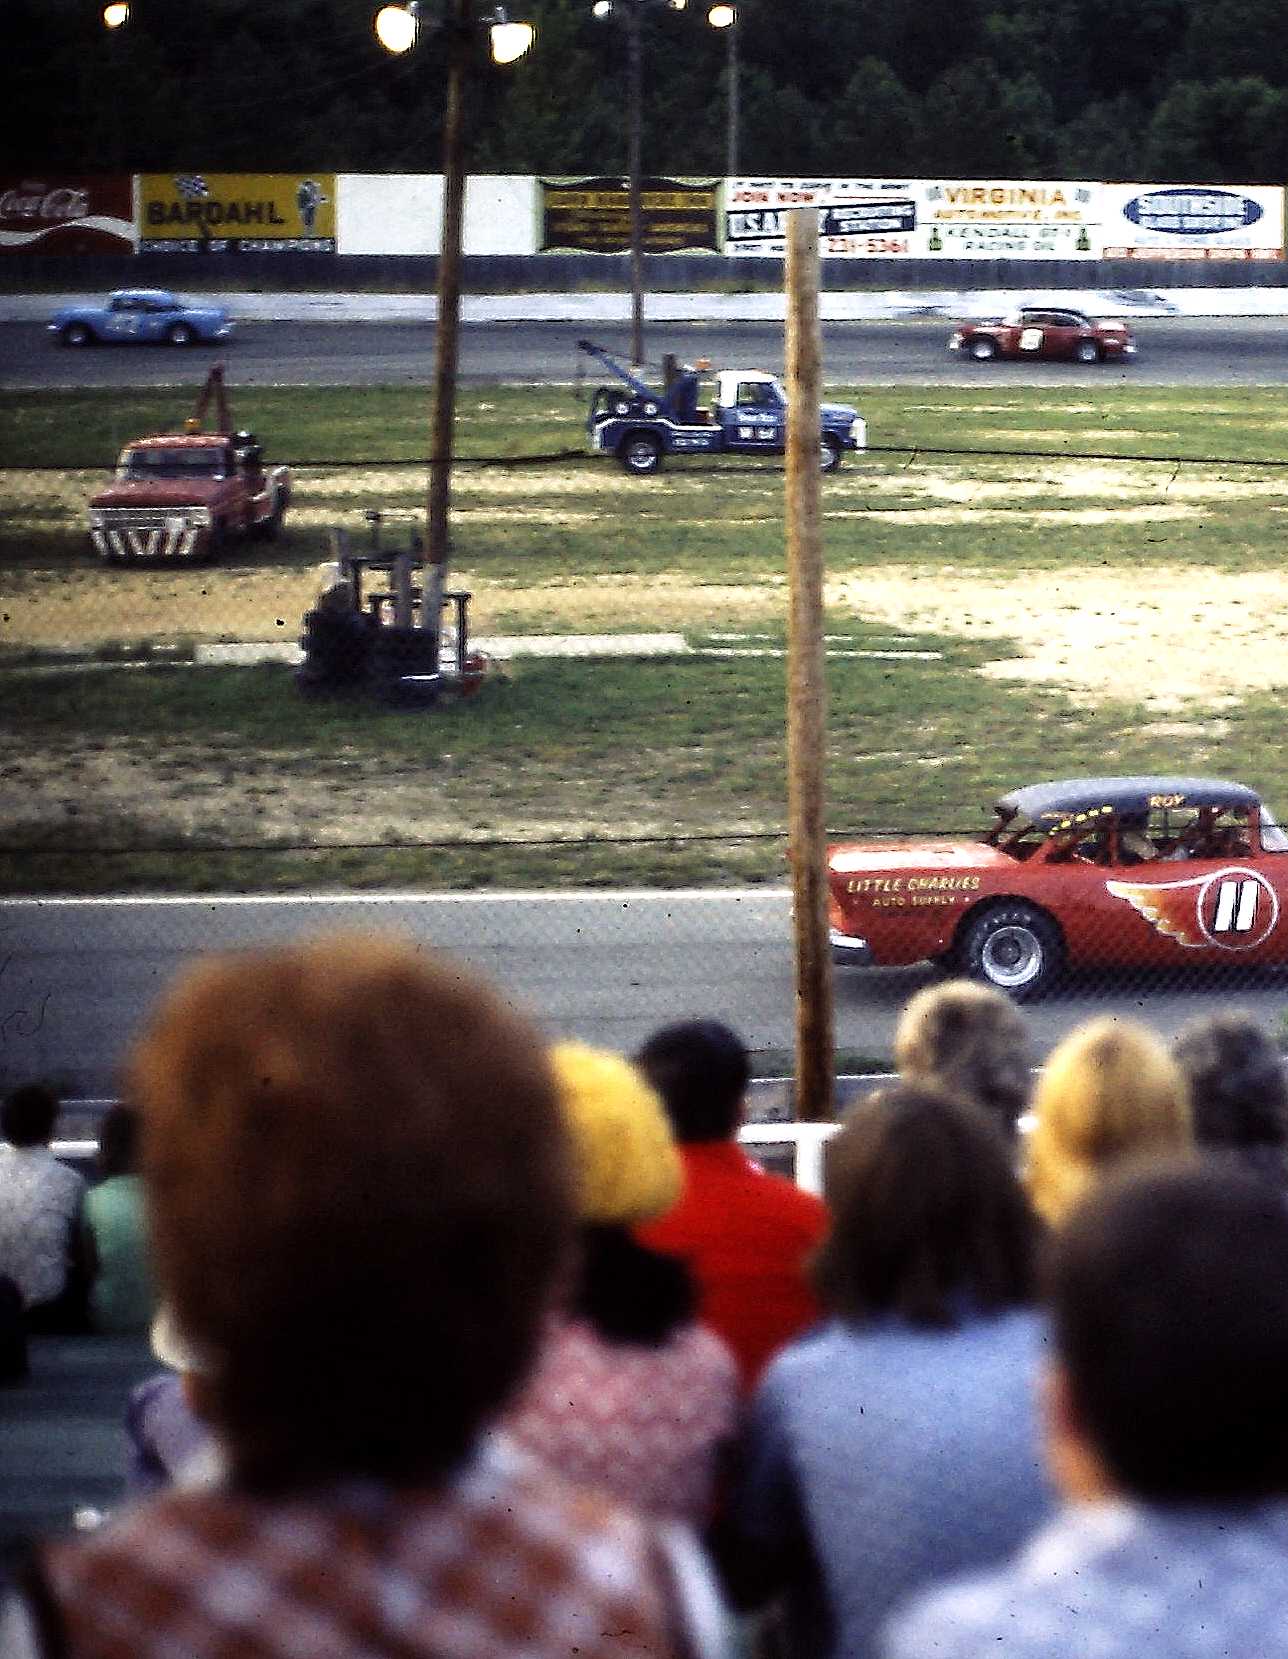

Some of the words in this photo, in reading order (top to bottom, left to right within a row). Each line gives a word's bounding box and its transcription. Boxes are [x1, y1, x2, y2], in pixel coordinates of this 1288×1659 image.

[944, 187, 1067, 205] VIRGINIA
[147, 201, 285, 226] BARDAHL
[946, 227, 1031, 239] KENDALL
[1150, 794, 1185, 808] ROY
[847, 879, 902, 894] LITTLE
[907, 876, 981, 891] CHARLIES
[871, 897, 906, 908] AUTO
[1214, 880, 1258, 932] 11
